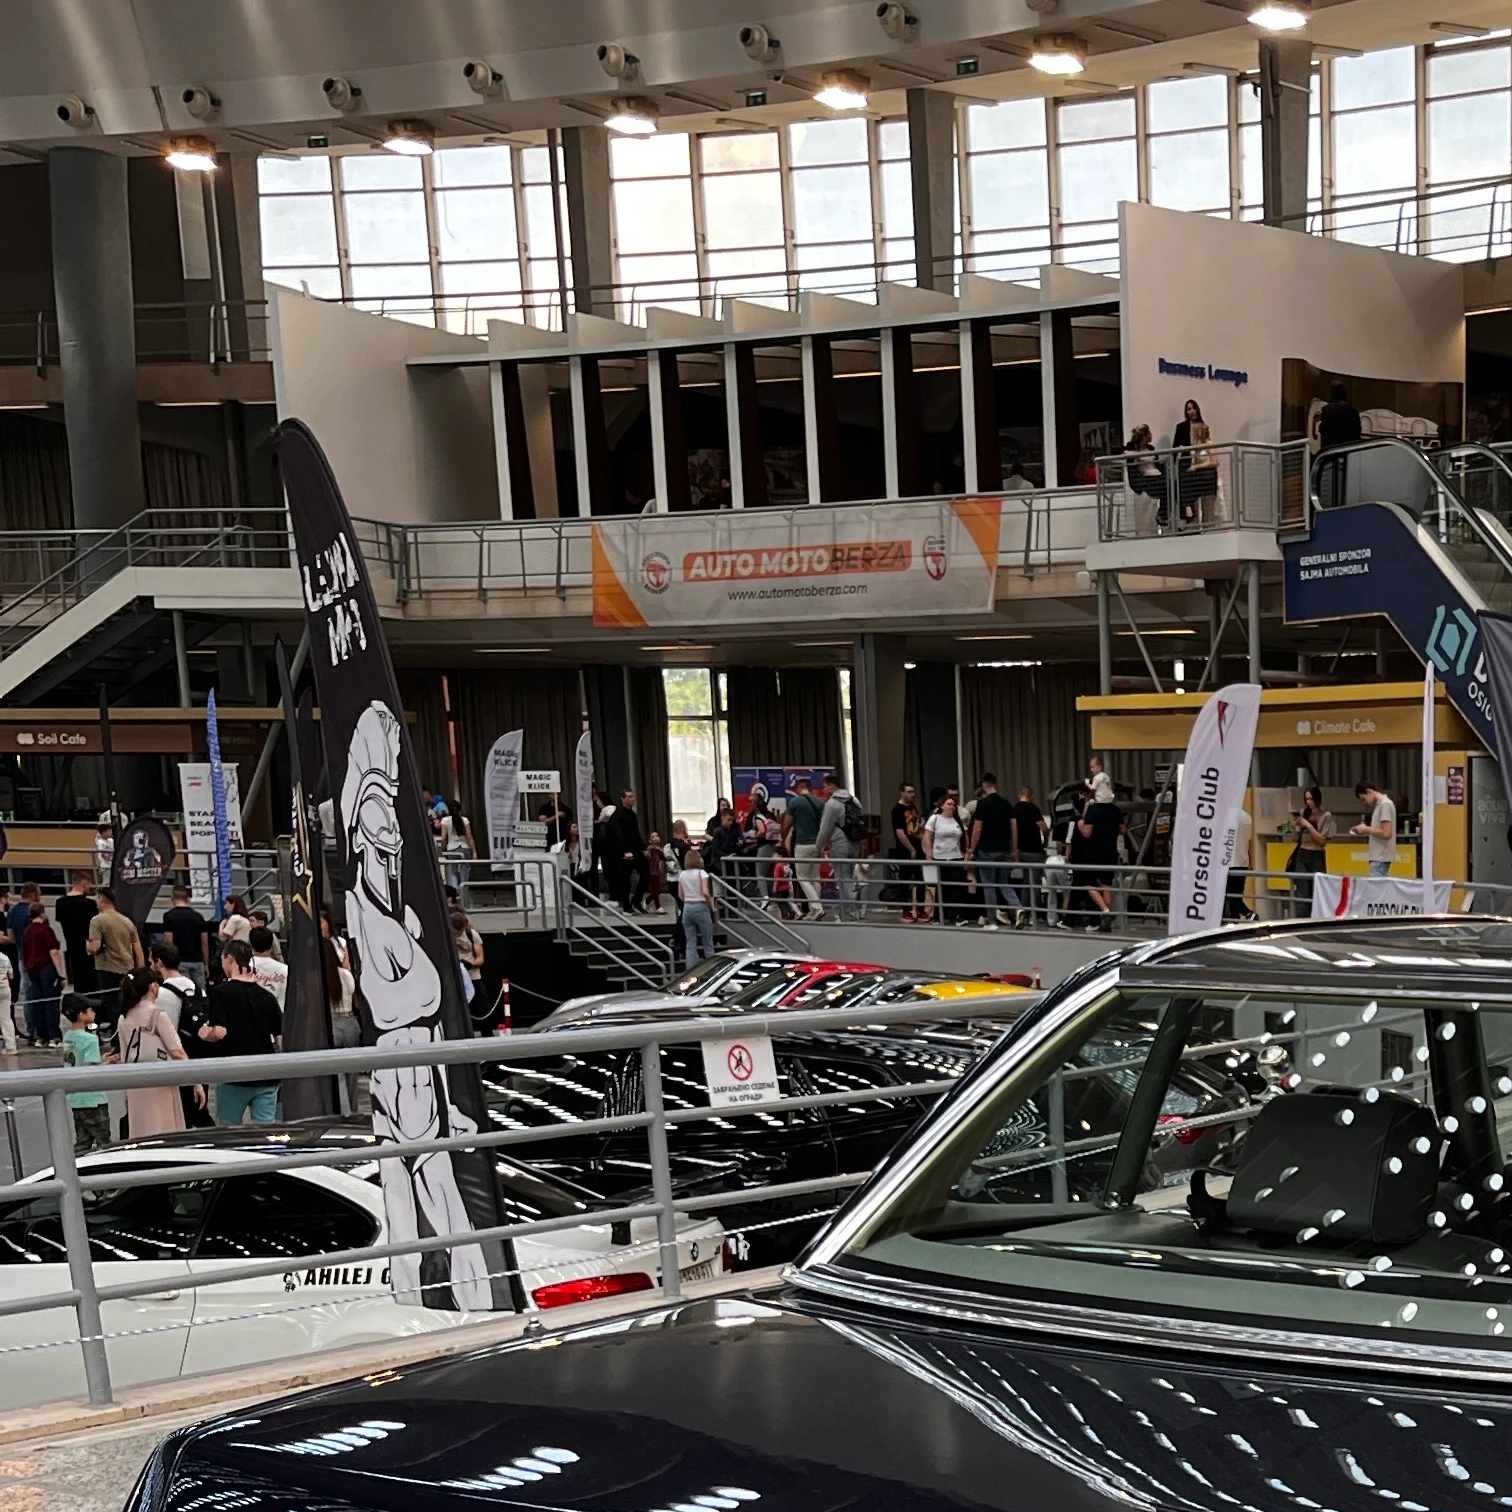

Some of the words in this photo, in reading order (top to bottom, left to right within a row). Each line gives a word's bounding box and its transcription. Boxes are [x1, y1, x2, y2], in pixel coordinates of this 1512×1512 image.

[1208, 364, 1248, 387] Lounge
[688, 552, 754, 580] AUTO
[760, 541, 907, 576] MOTOBERZA
[1300, 552, 1338, 567] GENERALNI
[1338, 548, 1372, 562] SPONZOR
[1300, 566, 1323, 581] SAJMA
[1324, 563, 1370, 579] AUTOMOBILA
[727, 583, 868, 601] www.automotoberza.com
[1314, 720, 1351, 734] Climate
[1353, 718, 1377, 733] Cafe
[37, 733, 58, 745] Soil
[60, 733, 87, 745] Cafe
[1196, 766, 1220, 821] Club
[1222, 828, 1236, 867] Serbia
[1186, 826, 1214, 921] Porsche
[304, 1267, 373, 1286] AHILEJ
